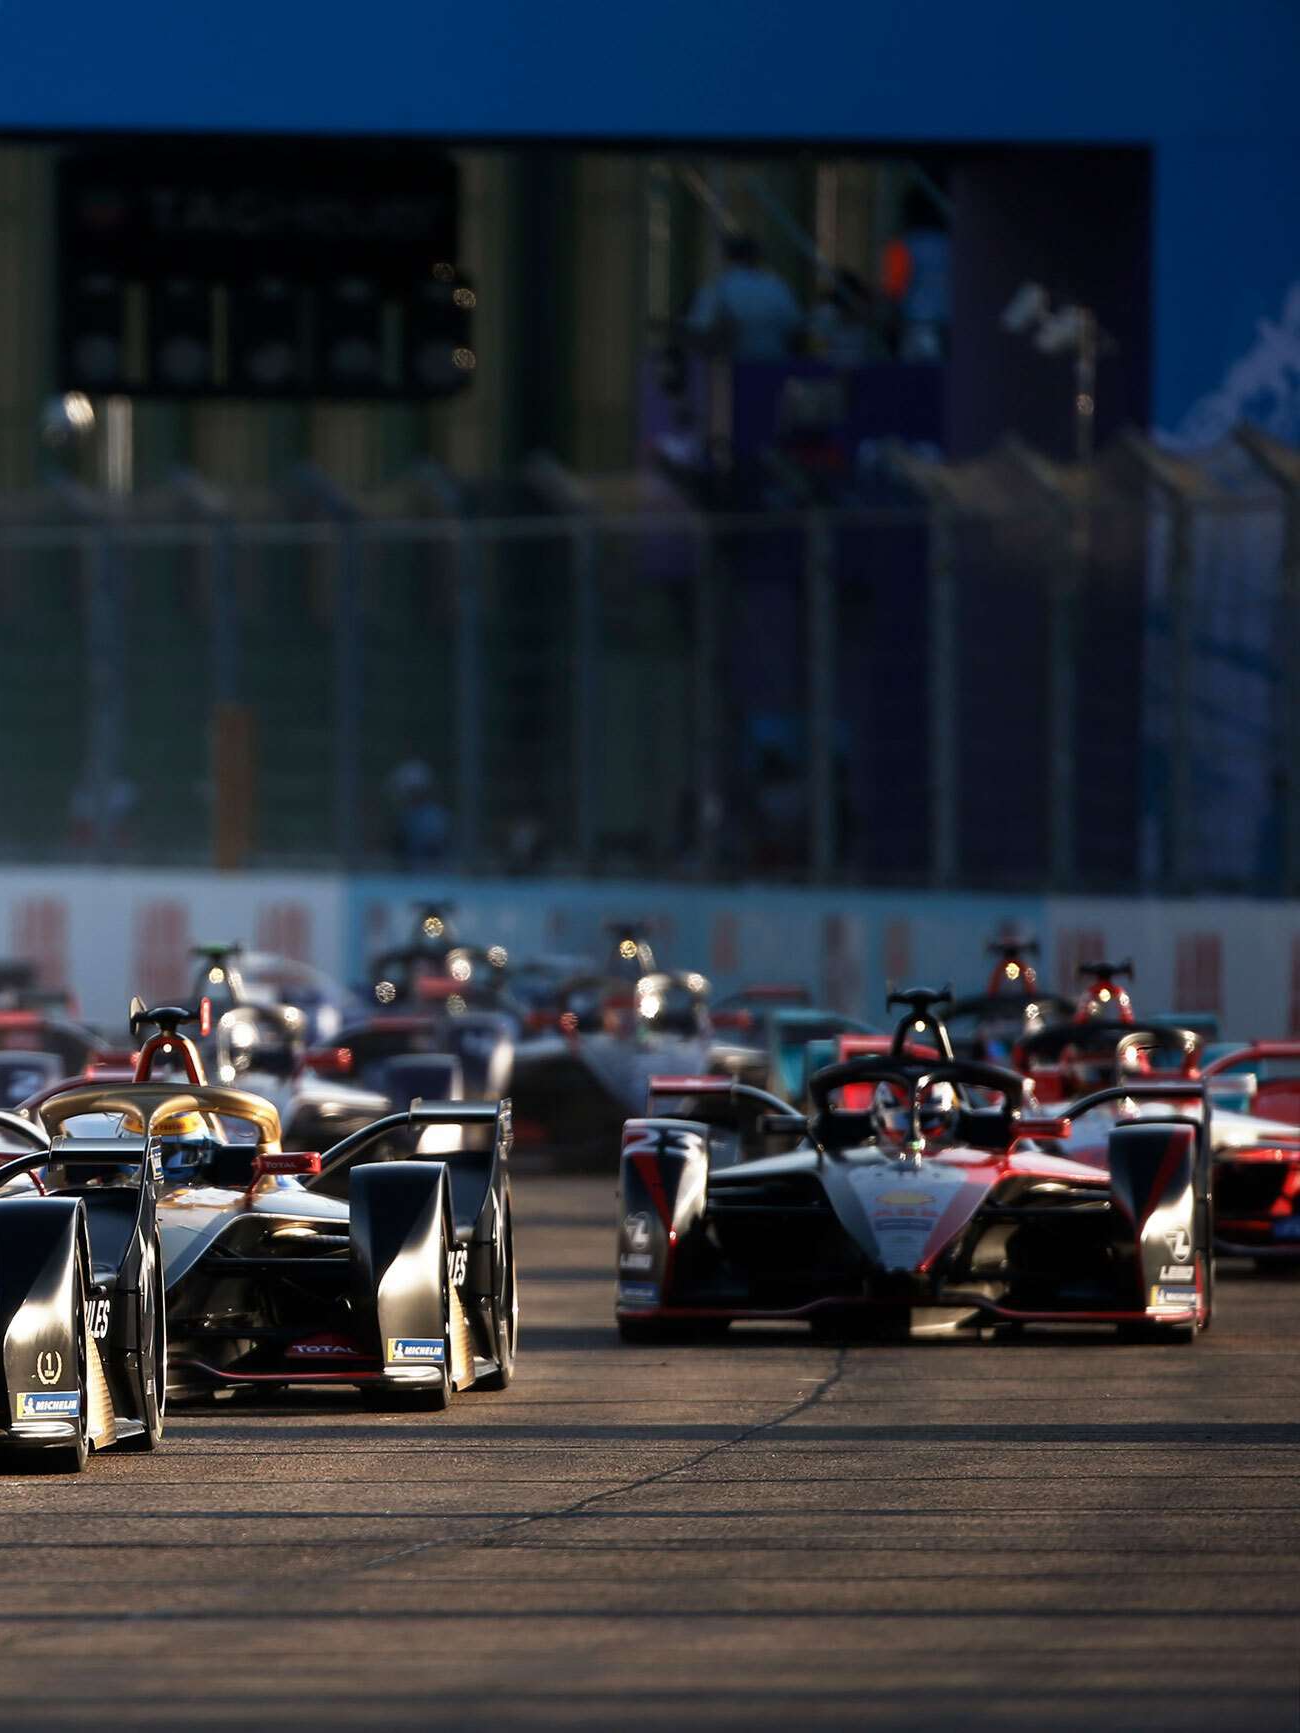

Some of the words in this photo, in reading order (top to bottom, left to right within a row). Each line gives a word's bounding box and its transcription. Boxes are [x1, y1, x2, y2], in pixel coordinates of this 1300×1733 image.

[265, 1161, 297, 1169] TOTAL
[292, 1345, 359, 1354] TOTAL
[404, 1346, 443, 1356] MICHELIN
[34, 1399, 78, 1411] MICHELIN
